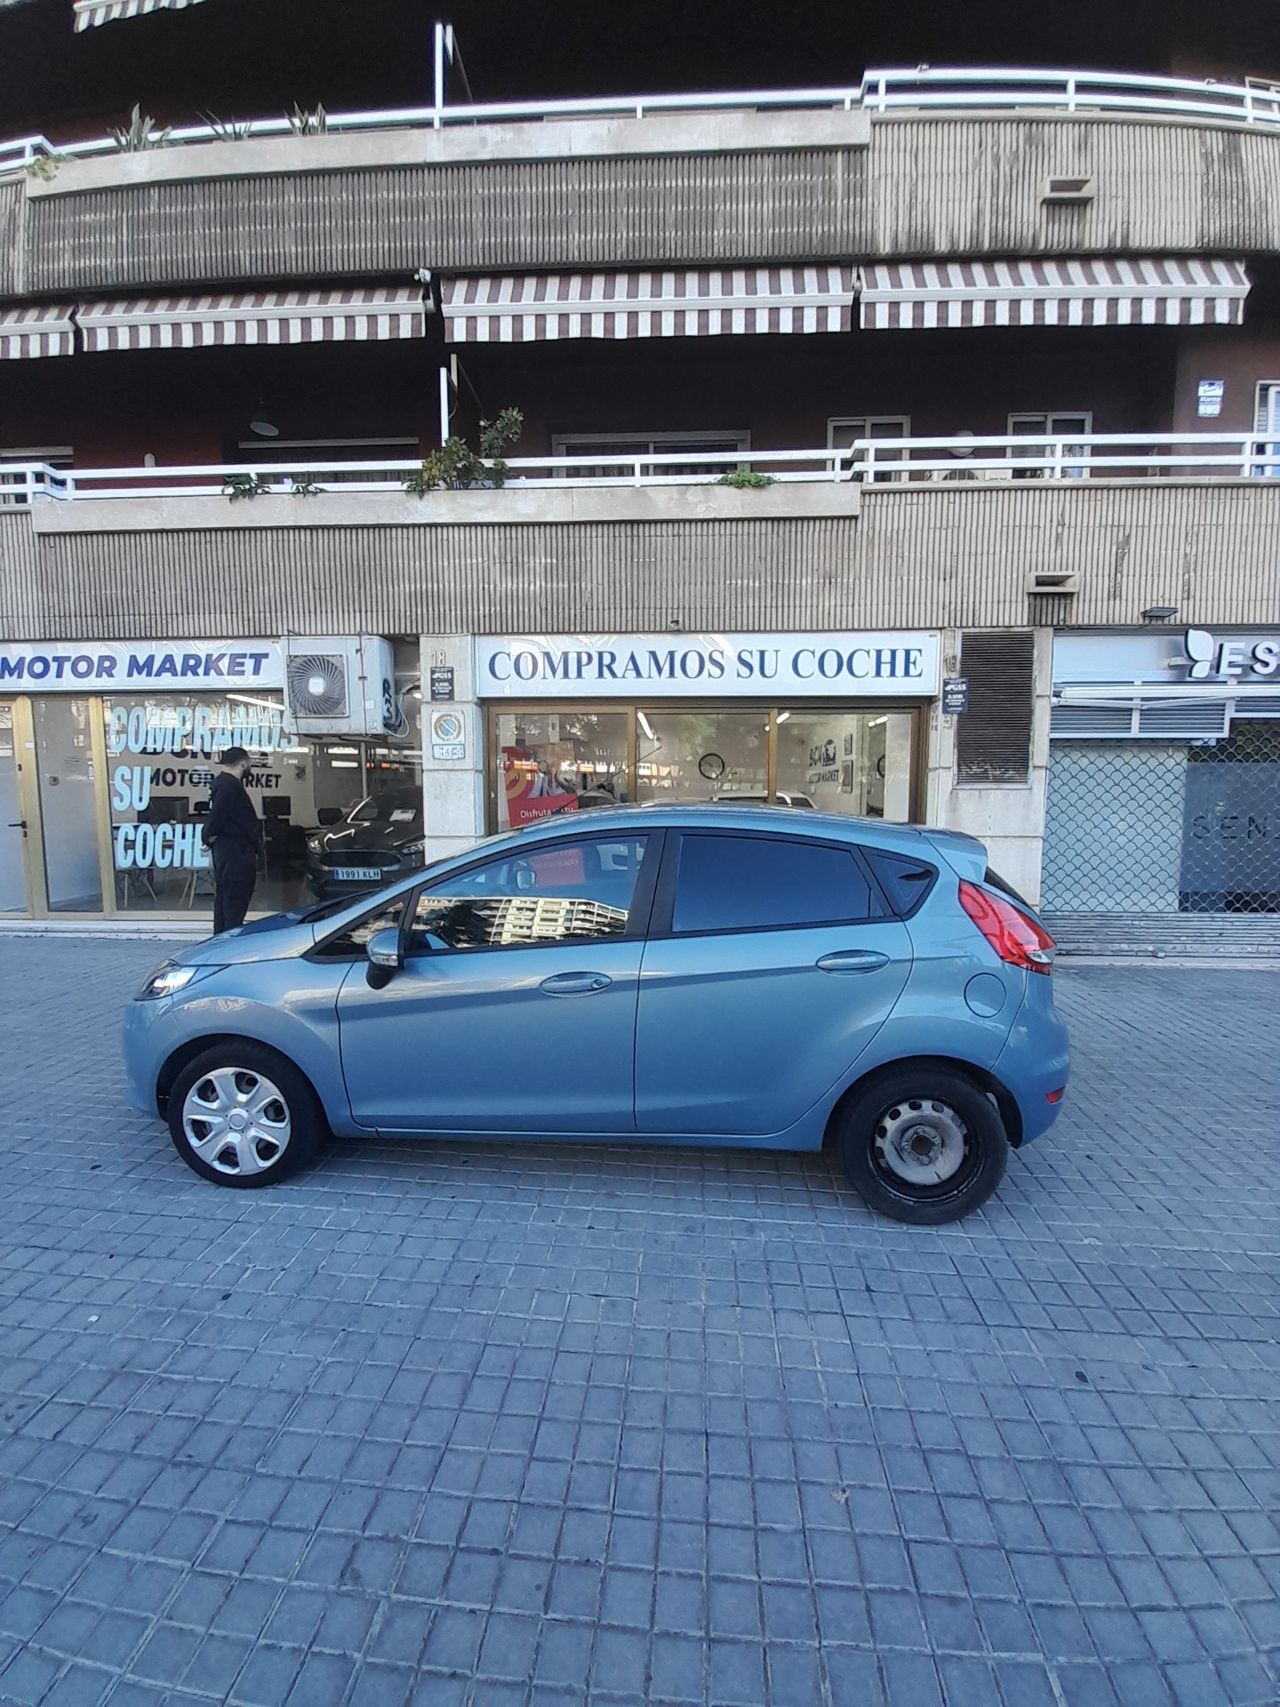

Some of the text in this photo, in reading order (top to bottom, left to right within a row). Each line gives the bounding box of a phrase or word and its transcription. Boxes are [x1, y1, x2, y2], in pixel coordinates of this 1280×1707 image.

[0, 652, 270, 679] MOTOR MARKET
[431, 649, 447, 668] 18
[488, 648, 924, 680] COMPRAMOS SU COCHE
[112, 765, 151, 811] SU
[520, 808, 551, 818] Disfruta
[341, 869, 380, 879] 1991 KLH
